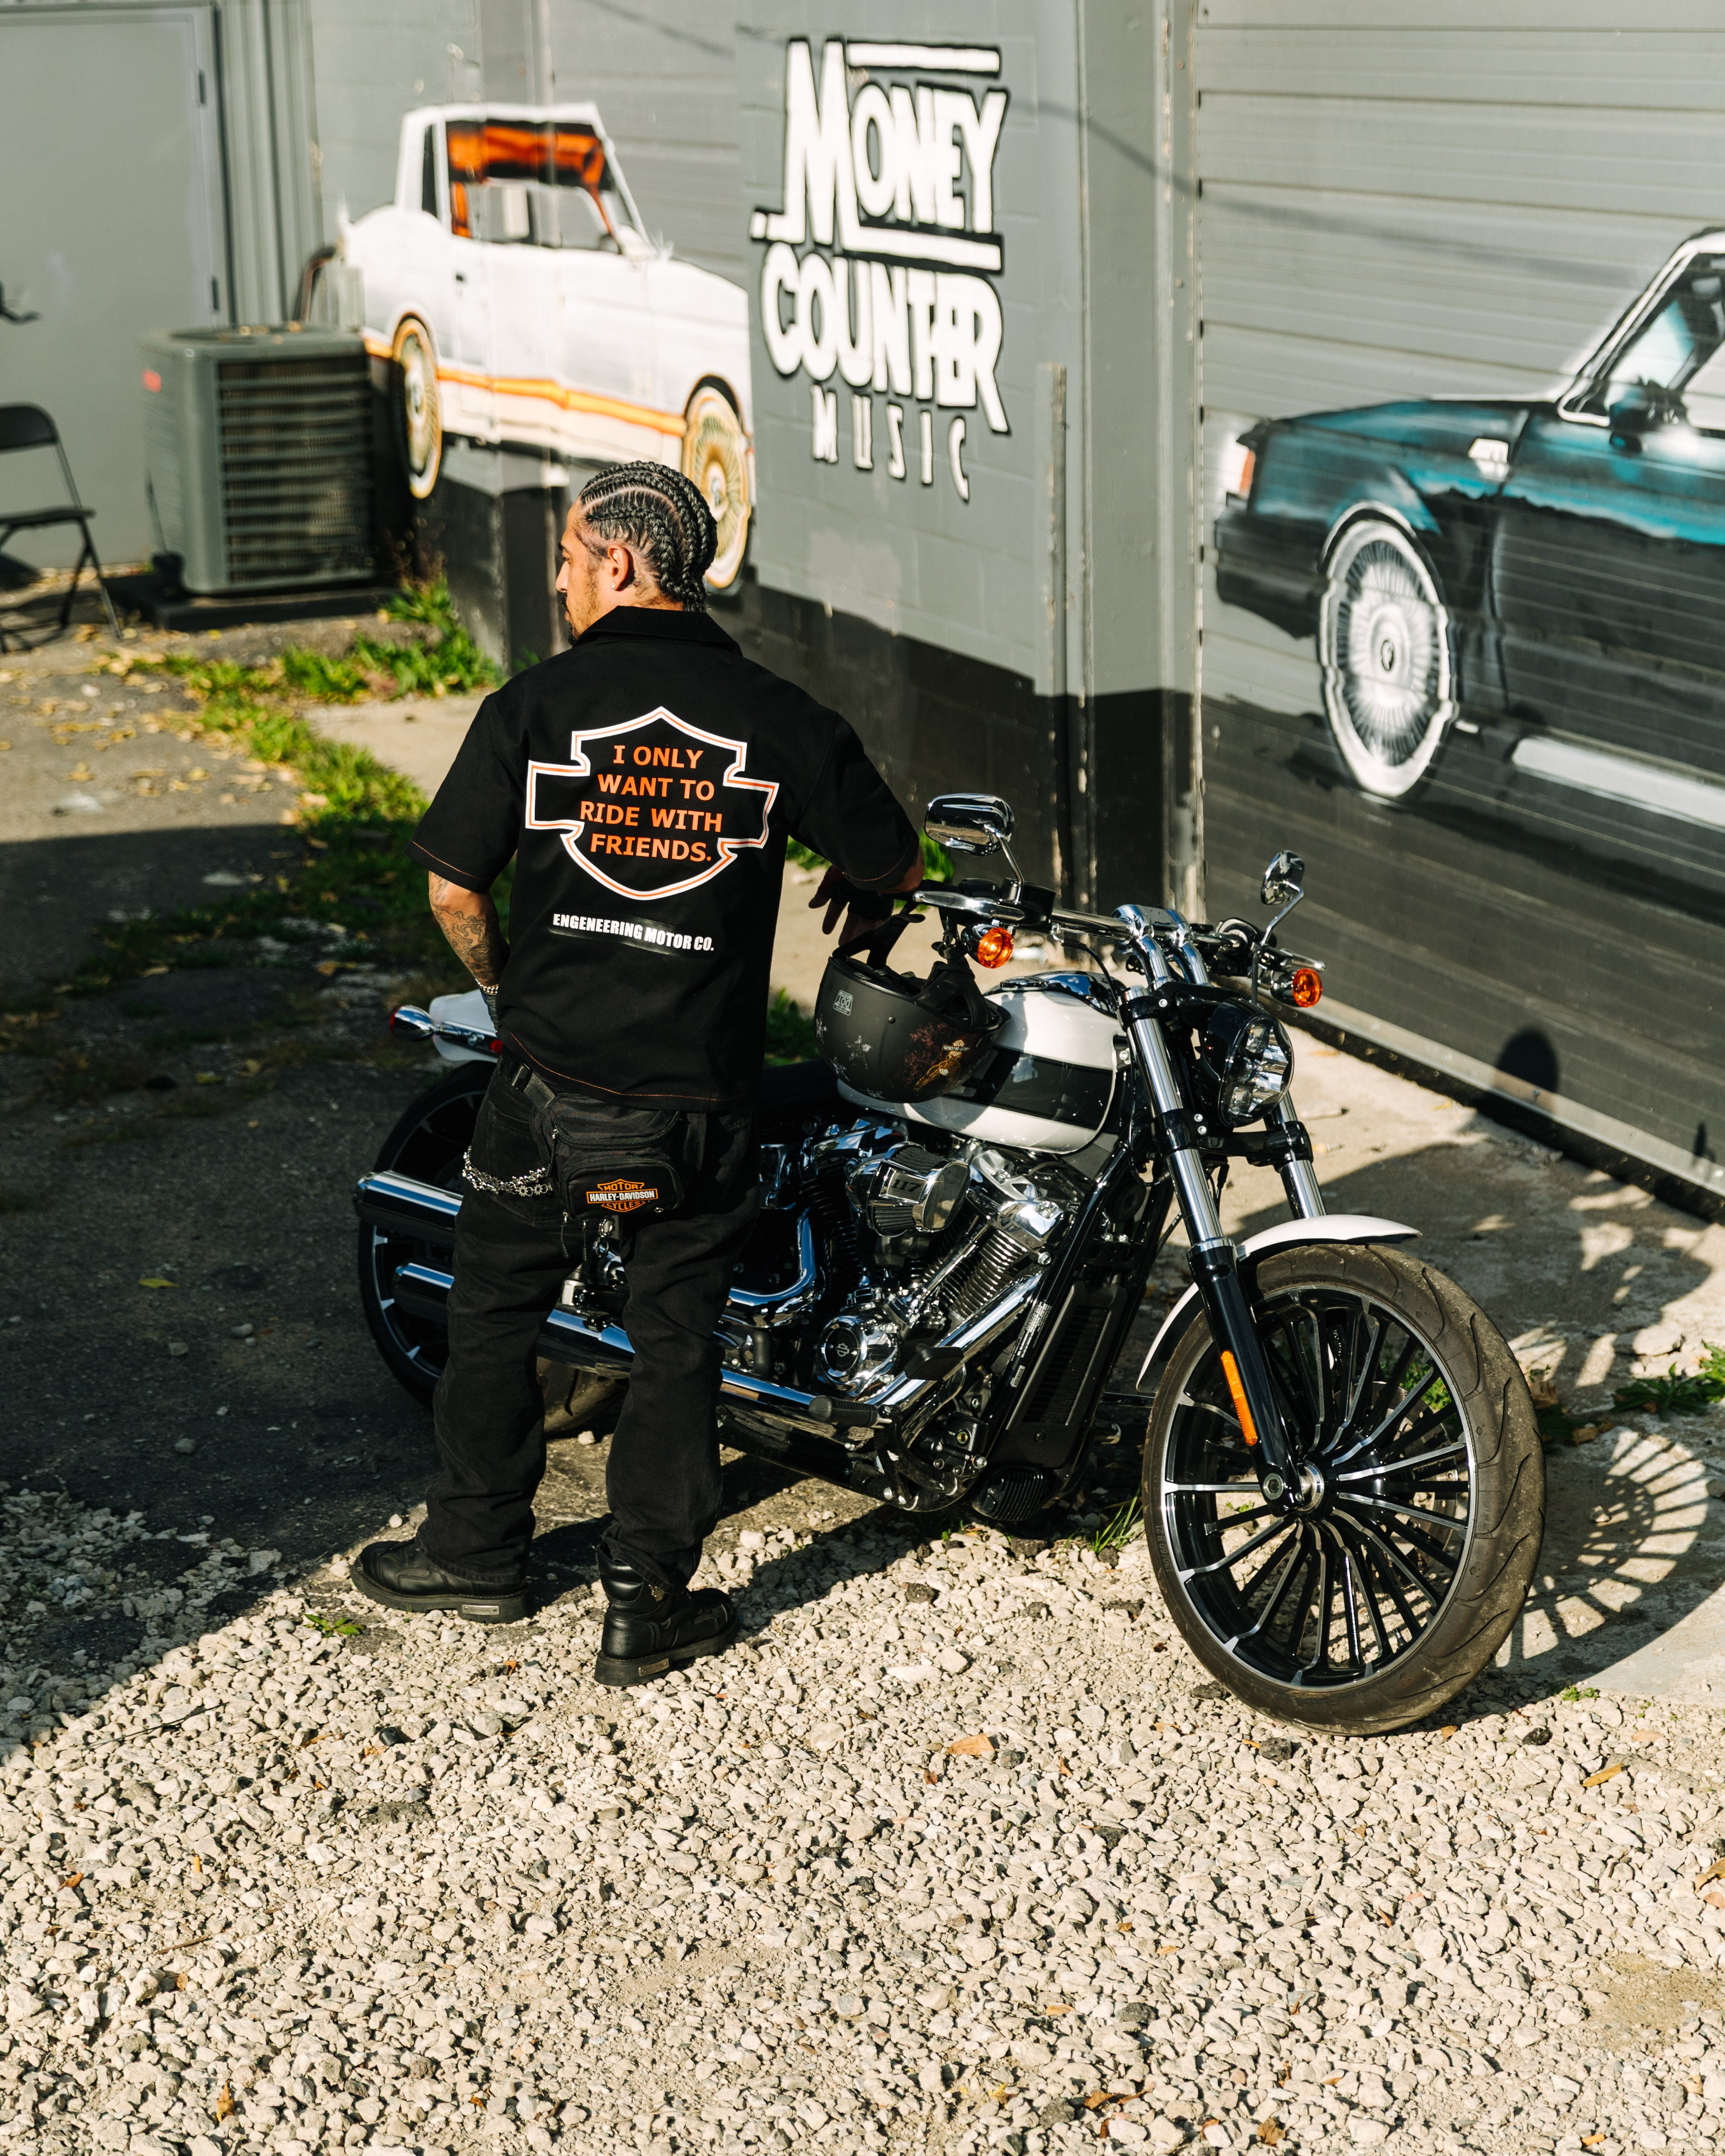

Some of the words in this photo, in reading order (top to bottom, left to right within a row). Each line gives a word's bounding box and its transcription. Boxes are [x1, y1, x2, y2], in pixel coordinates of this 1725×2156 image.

[761, 241, 1010, 434] COUNTER
[811, 383, 970, 502] MUSIC
[613, 745, 626, 764] I
[633, 746, 704, 769] ONLY
[597, 774, 674, 797] WANT
[680, 779, 715, 801] TO
[580, 800, 641, 826] RIDE
[651, 808, 723, 833] WITH
[590, 833, 712, 862] FRIENDS.
[552, 913, 643, 940] ENGENEERING
[643, 926, 692, 950] MOTOR
[693, 936, 715, 951] CO.
[837, 995, 851, 1009] DOT
[589, 1190, 655, 1202] HARLEY-DAVIDSON
[603, 1181, 638, 1191] MOTOR
[890, 1179, 923, 1193] 117
[606, 1201, 641, 1211] CYCLES
